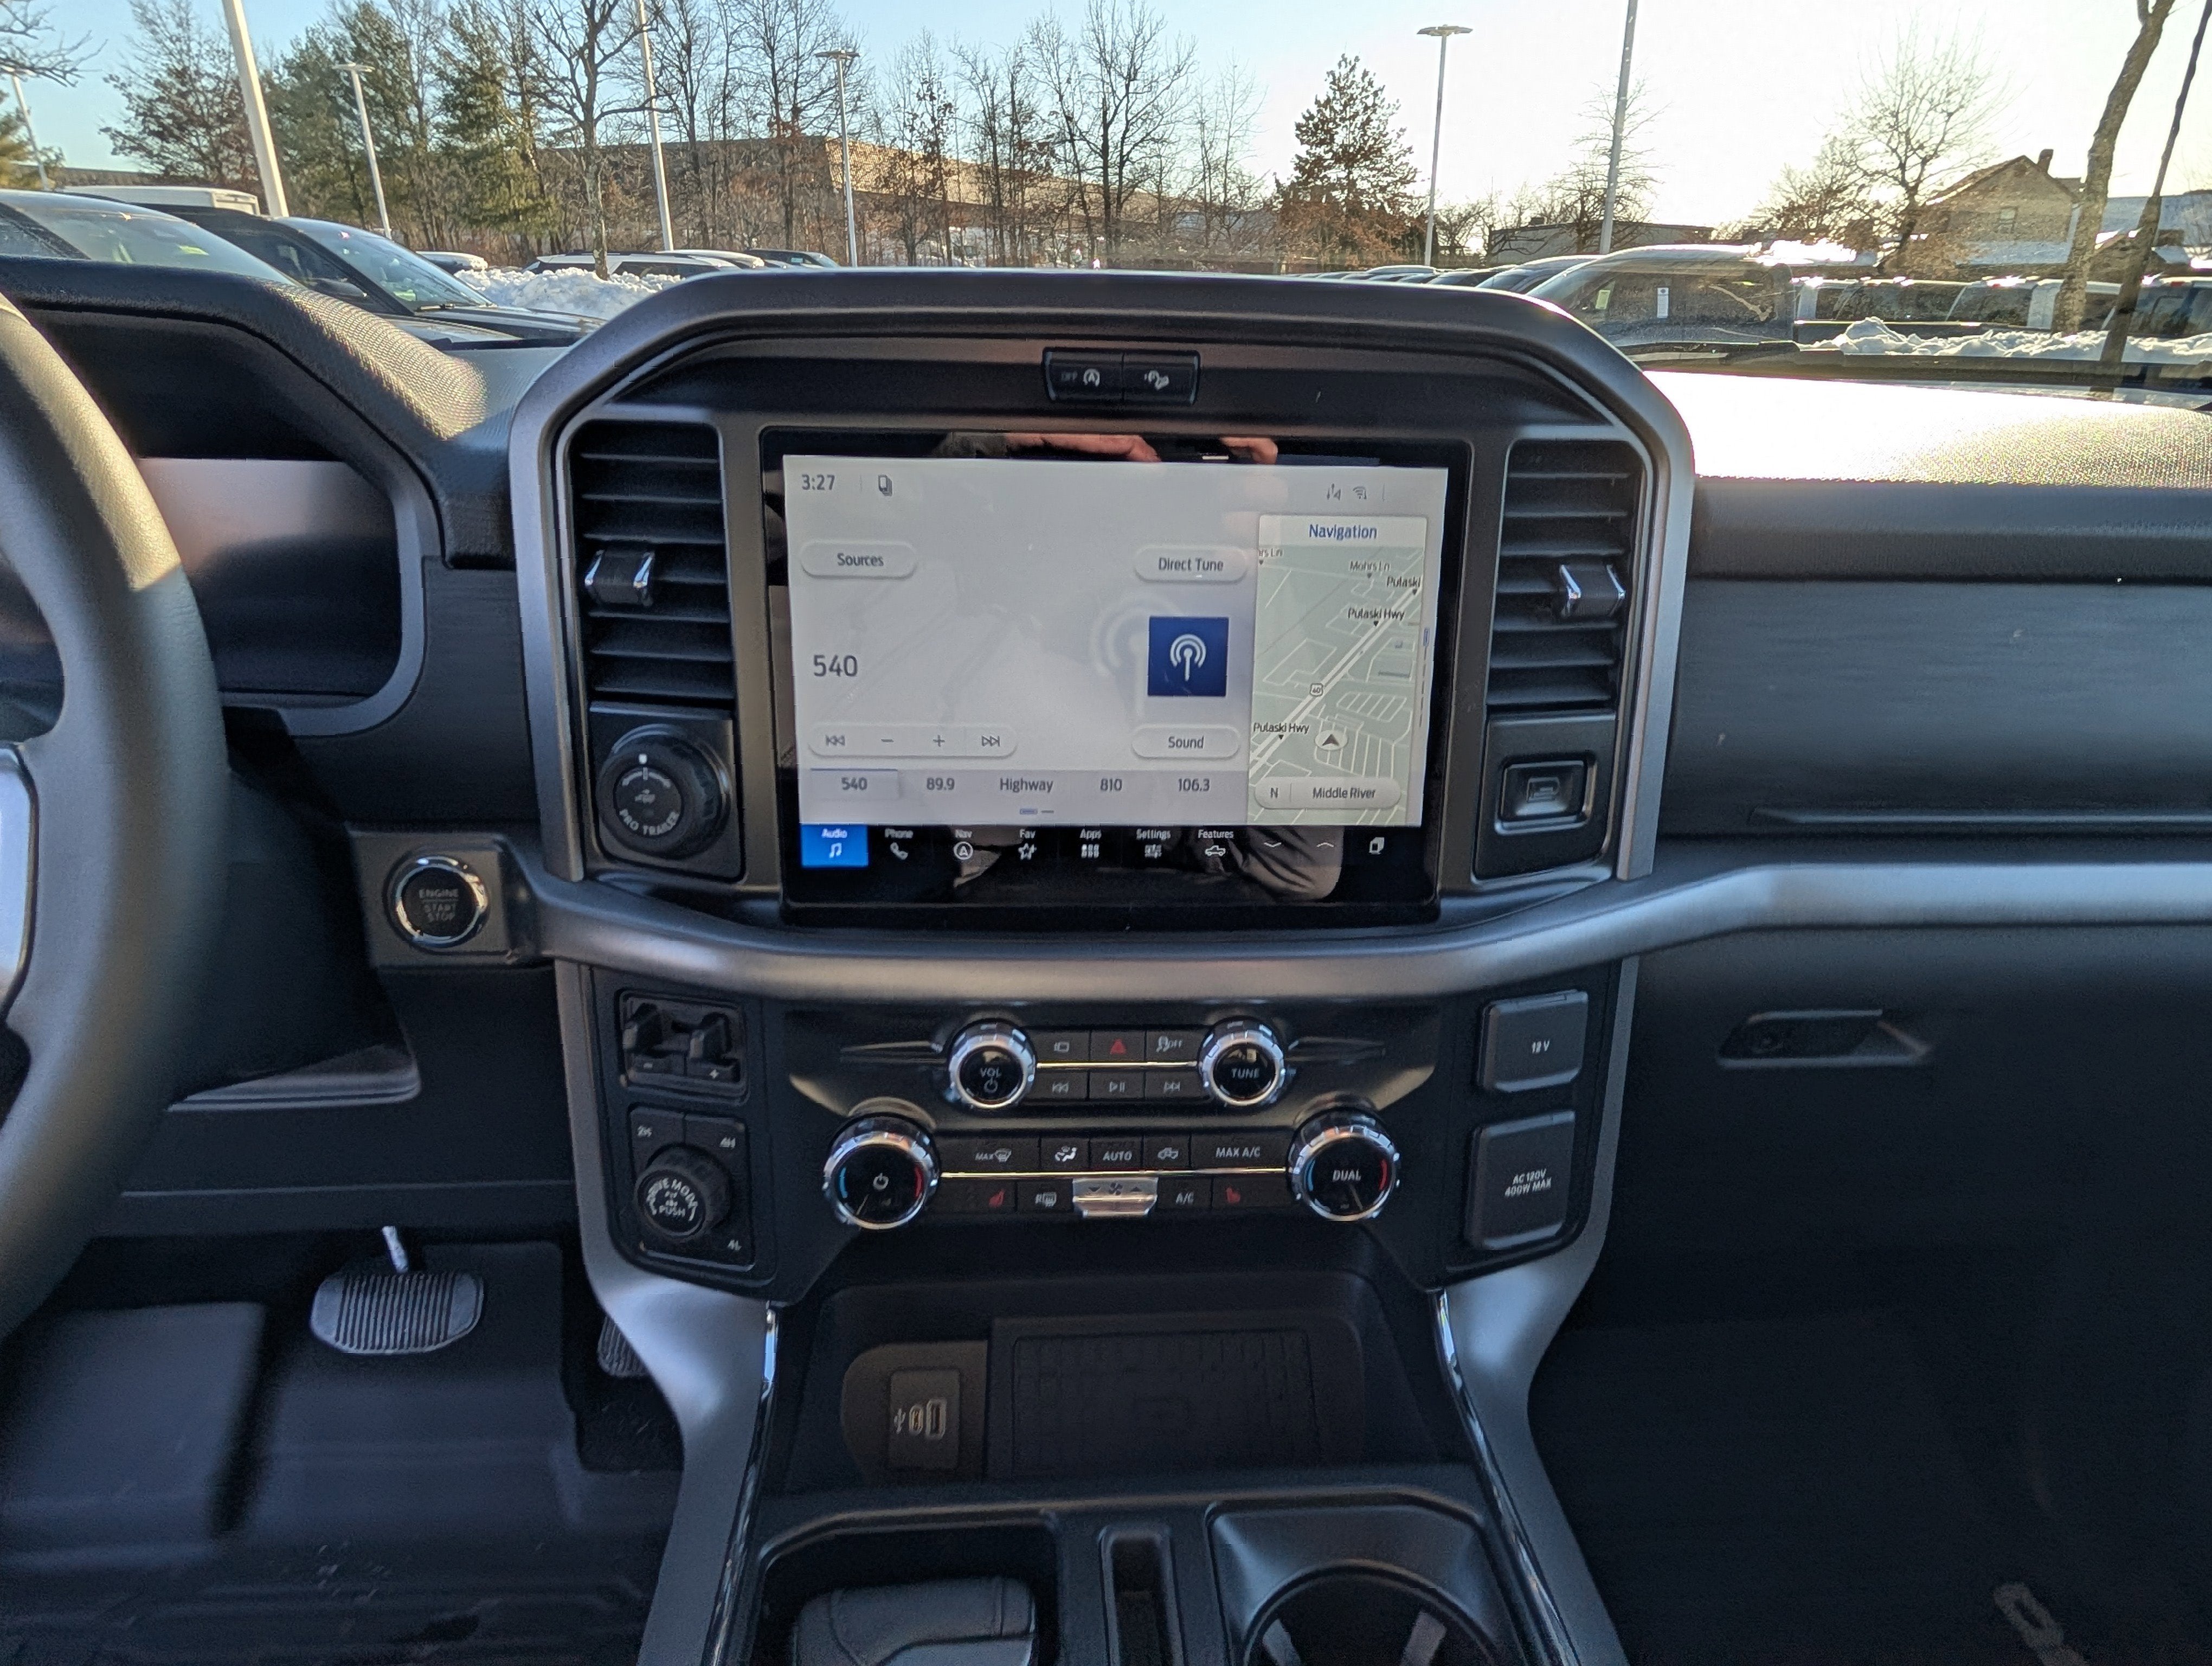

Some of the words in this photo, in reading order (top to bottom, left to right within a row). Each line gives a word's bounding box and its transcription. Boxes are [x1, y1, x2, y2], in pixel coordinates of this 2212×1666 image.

[801, 474, 835, 490] 3:27
[1309, 524, 1378, 541] Navigation
[837, 553, 884, 567] Sources
[1159, 558, 1192, 571] Direct
[1195, 558, 1224, 572] Tune
[1349, 561, 1377, 571] Mohrs
[1386, 576, 1421, 588] Pulaski
[1348, 607, 1382, 619] Pulaski
[1384, 608, 1405, 620] Hwy
[813, 655, 858, 677] 540
[1253, 722, 1287, 733] Pulaski
[1288, 723, 1309, 735] Hwy
[1168, 736, 1204, 749] Sound
[841, 778, 867, 790] 540
[927, 778, 955, 790] 89.9
[1000, 778, 1053, 793] Highway
[1100, 779, 1122, 791] 810
[1178, 779, 1210, 792] 106.3
[1270, 788, 1278, 798] N
[1313, 787, 1348, 798] Middle
[1350, 788, 1376, 799] River
[821, 828, 847, 838] Audio
[884, 828, 914, 838] Phone
[955, 829, 972, 839] Nav
[1020, 829, 1036, 839] Fav
[1081, 829, 1102, 840] Apps
[1136, 828, 1171, 840] Settings
[1198, 829, 1234, 839] Features
[418, 888, 460, 899] ENGINE
[424, 903, 456, 913] START
[427, 912, 456, 922] STOP
[980, 1067, 1001, 1078] VOL
[1231, 1068, 1259, 1079] TUNE
[1103, 1151, 1132, 1161] AUTO
[1216, 1147, 1239, 1157] MAX
[1242, 1146, 1261, 1158] A/C
[1333, 1169, 1361, 1181] DUAL
[1513, 1174, 1525, 1184] AC
[1526, 1168, 1547, 1182] 120V
[1504, 1183, 1531, 1197] 400W
[1532, 1177, 1552, 1192] MAX
[1175, 1192, 1193, 1204] A/C
